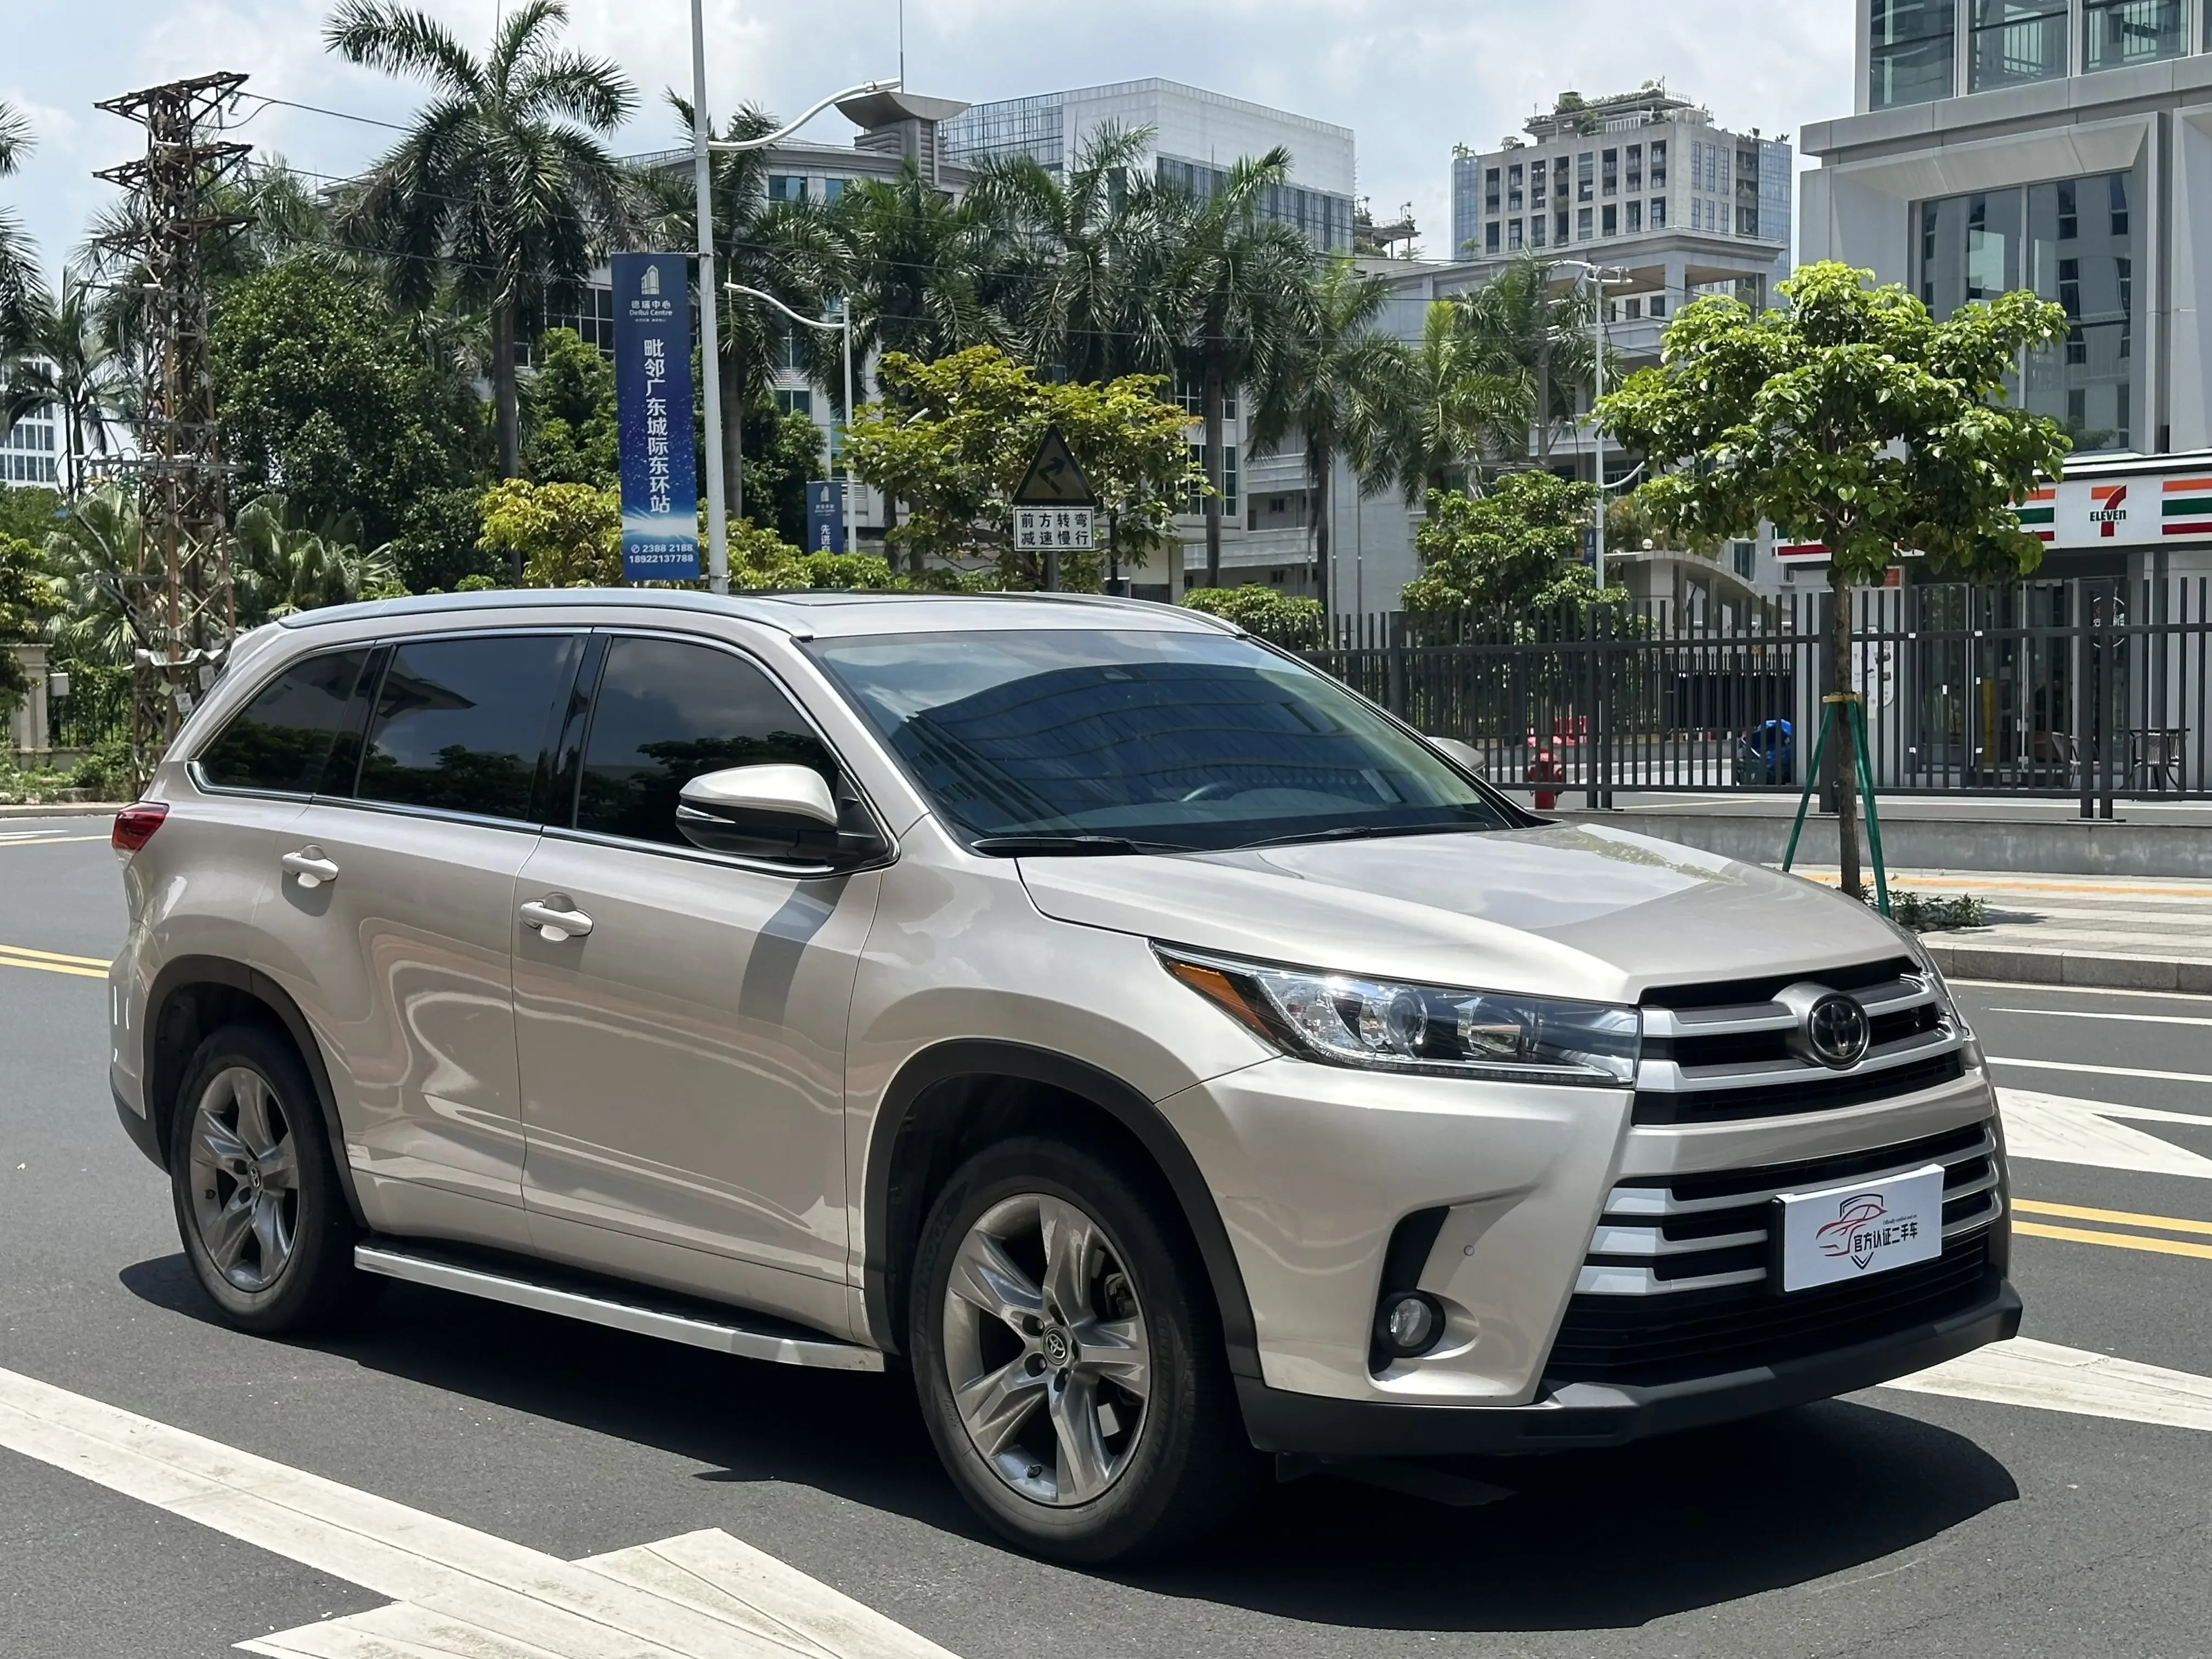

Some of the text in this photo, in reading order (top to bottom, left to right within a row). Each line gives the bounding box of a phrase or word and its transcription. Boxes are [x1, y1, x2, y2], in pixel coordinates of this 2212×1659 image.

[644, 338, 670, 514] 毗邻广东城际东环站
[1020, 512, 1088, 528] 前方转弯
[2091, 484, 2127, 538] 7
[669, 544, 693, 552] 2188
[1020, 531, 1089, 546] 减速慢行
[1854, 1222, 1918, 1252] 官方认证二手车
